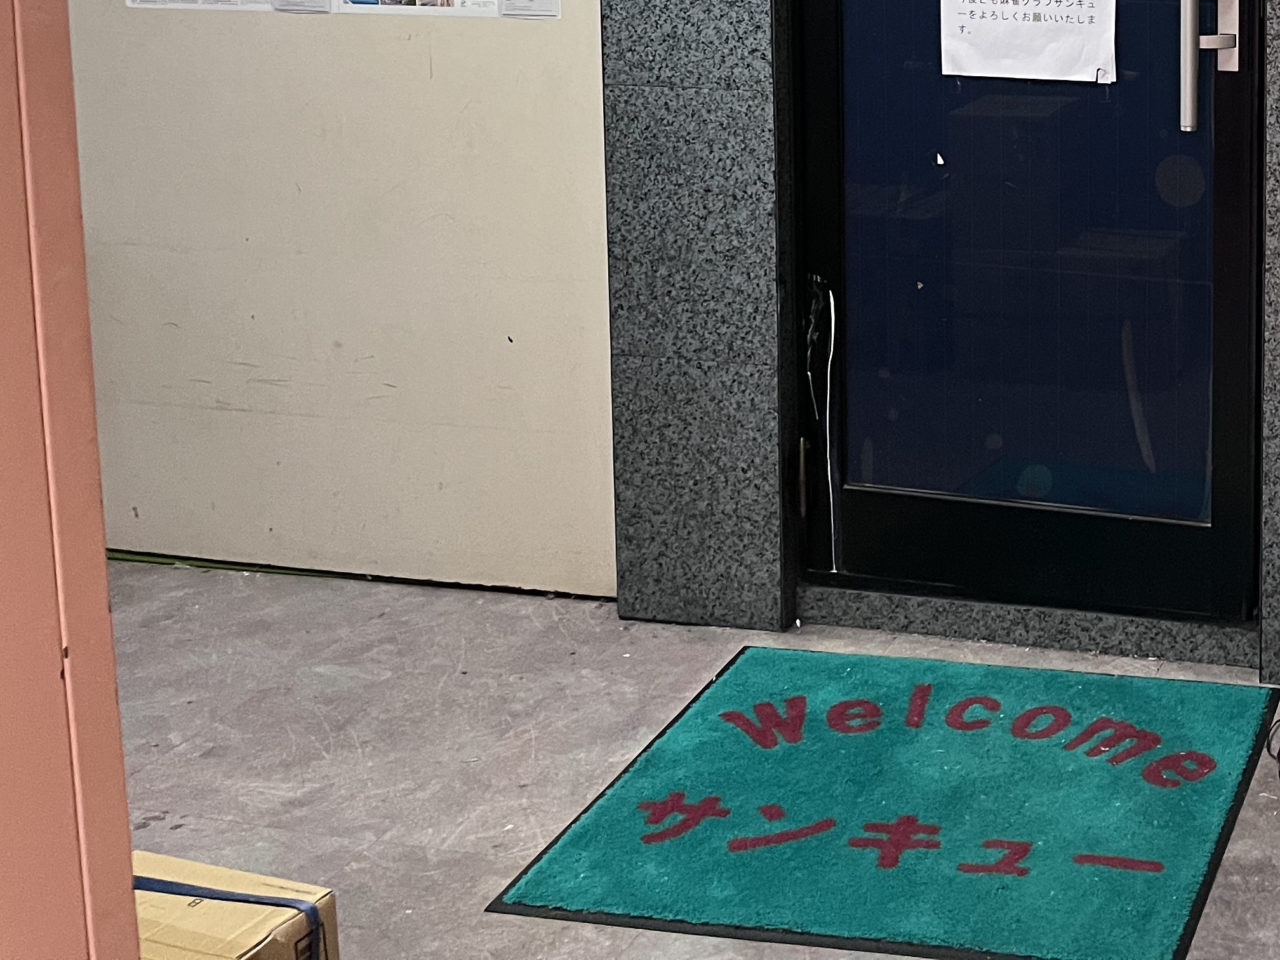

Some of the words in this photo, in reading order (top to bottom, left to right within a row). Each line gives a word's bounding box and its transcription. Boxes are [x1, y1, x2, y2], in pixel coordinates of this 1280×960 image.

[718, 683, 1217, 789] Welcome
[637, 791, 1164, 878] サンキュー
